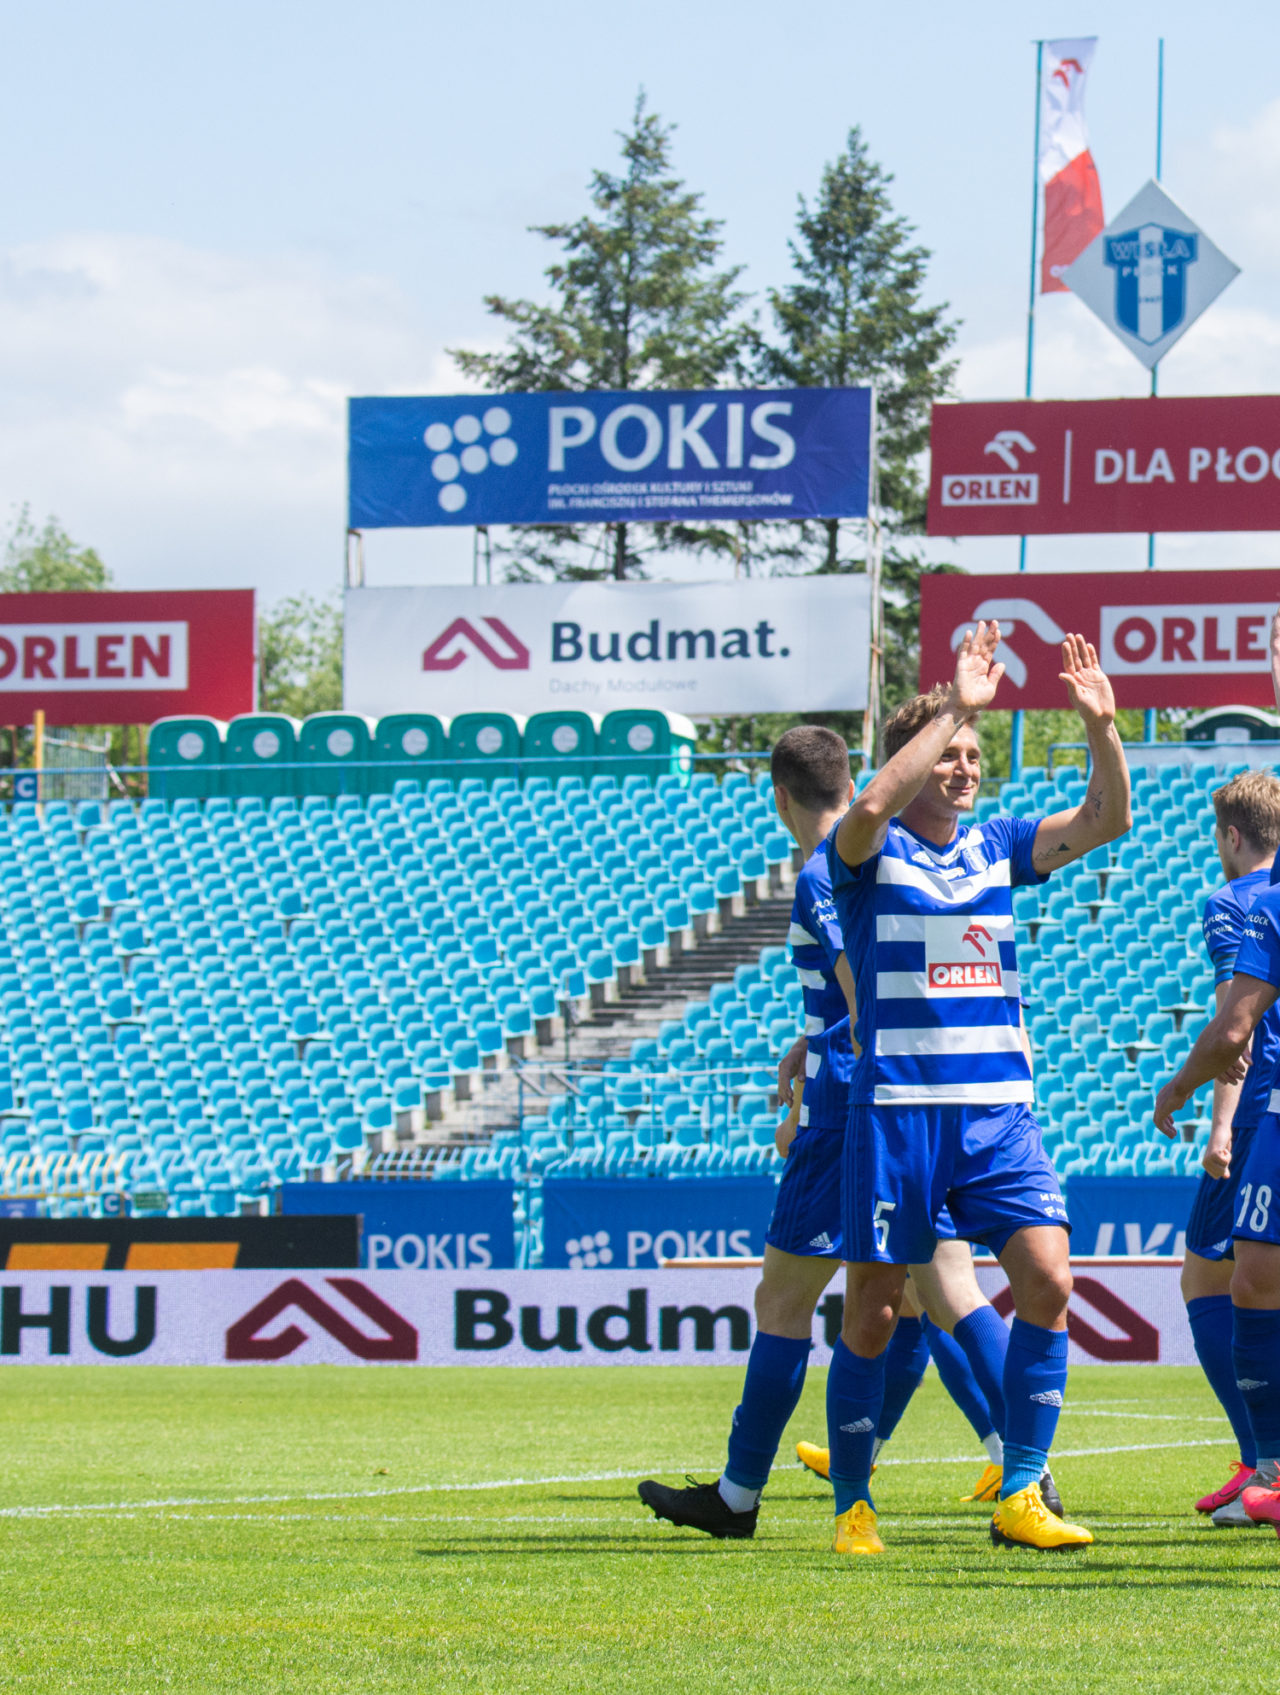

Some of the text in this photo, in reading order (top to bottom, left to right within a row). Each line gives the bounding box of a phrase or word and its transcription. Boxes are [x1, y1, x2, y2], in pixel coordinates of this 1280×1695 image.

[547, 401, 797, 472] POKIS
[1094, 447, 1175, 485] DLA
[948, 479, 1032, 501] ORLEN
[552, 619, 791, 663] Budmat.
[16, 777, 35, 799] C
[932, 964, 999, 985] ORLEN
[873, 1200, 896, 1253] 5
[1236, 1182, 1272, 1233] 18
[367, 1233, 493, 1269] POKIS
[628, 1229, 753, 1268] POKIS
[454, 1288, 845, 1352] Budmt
